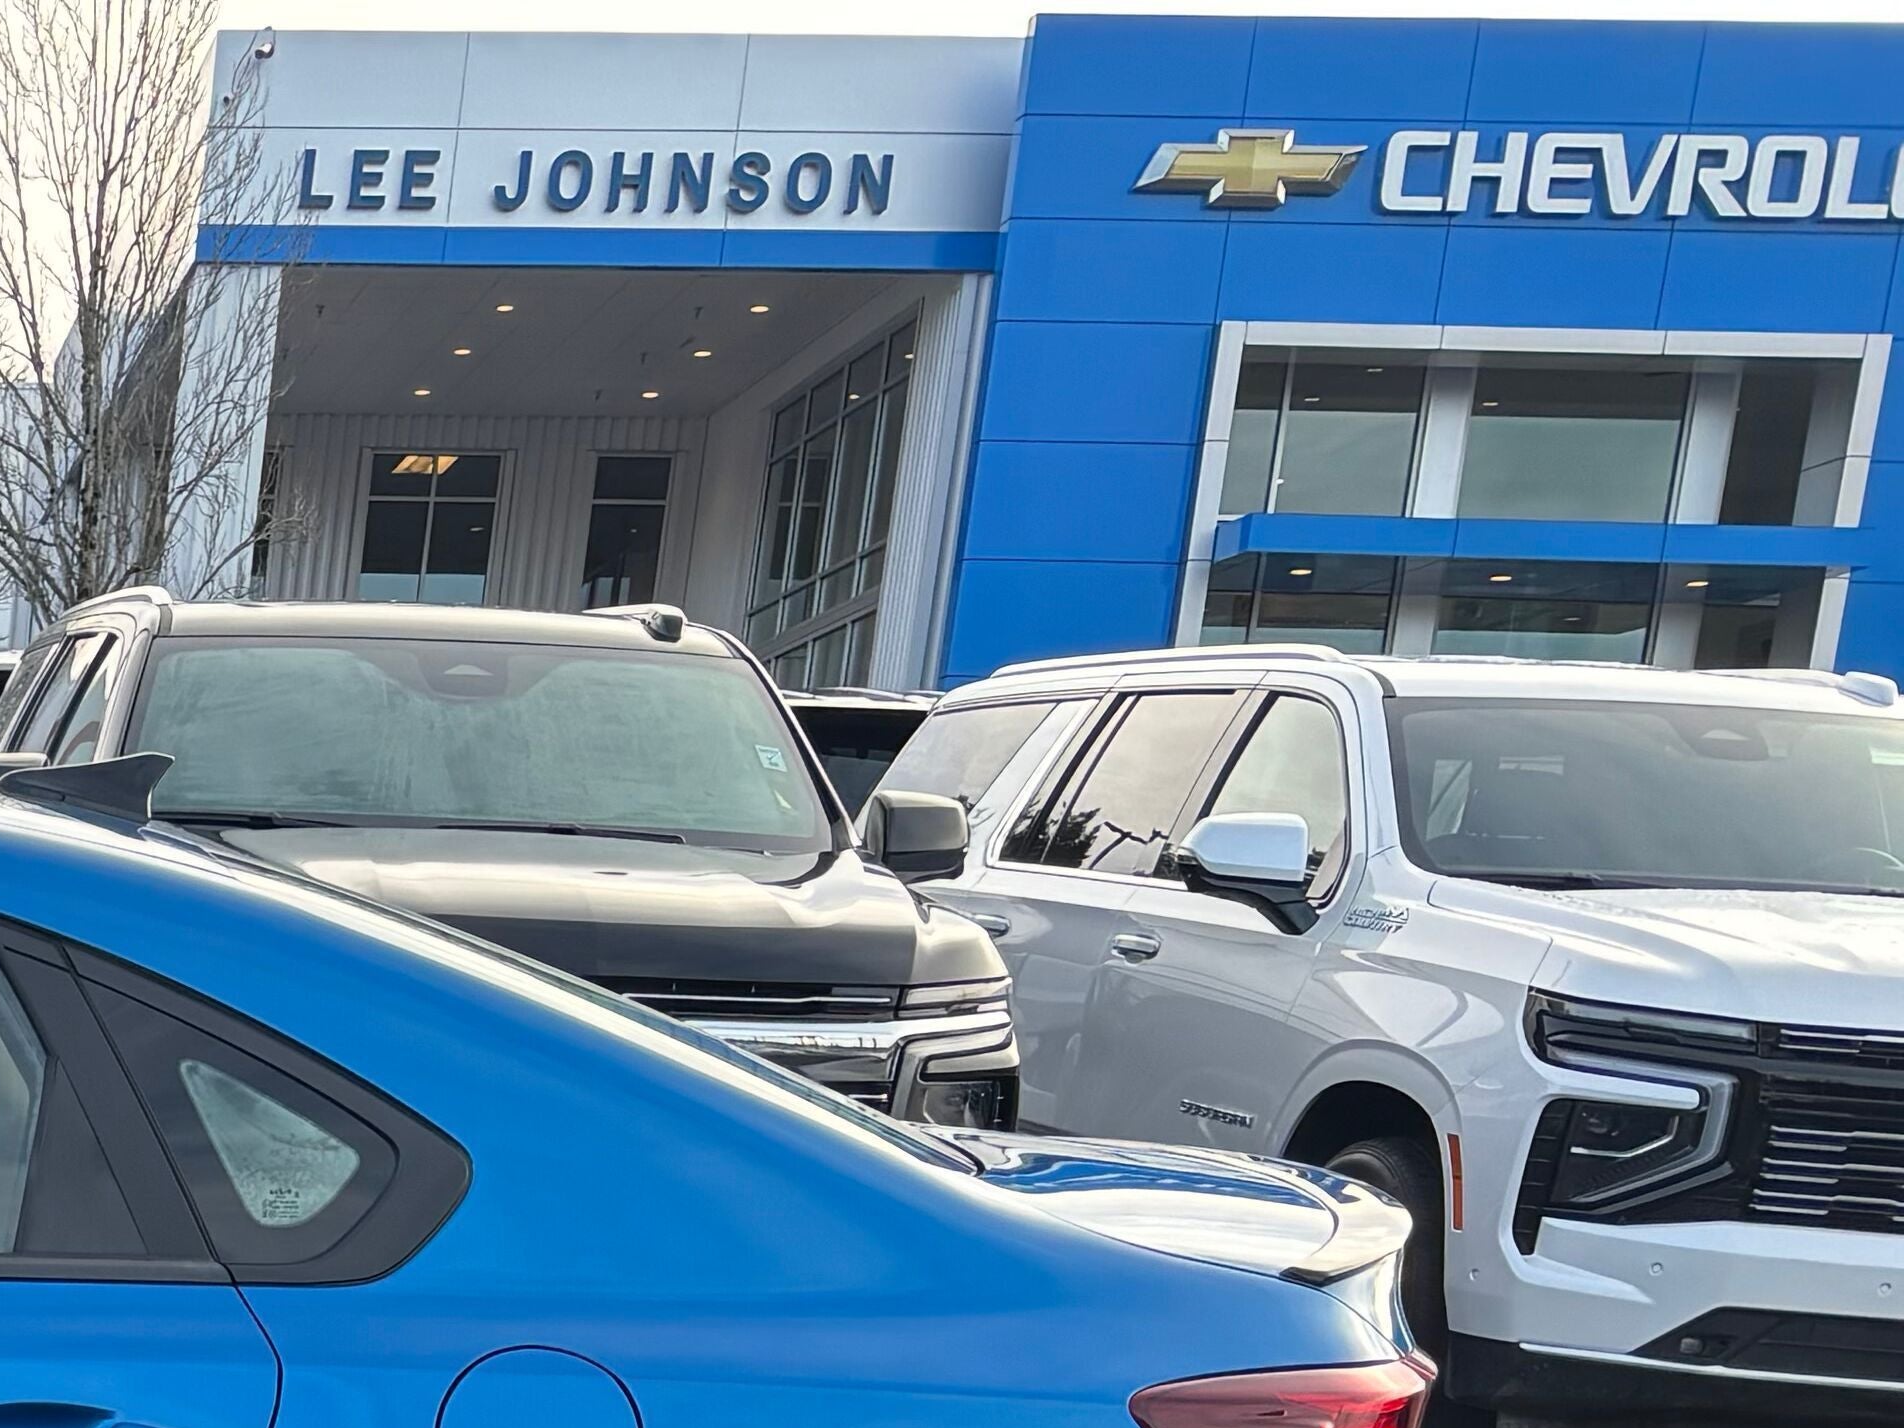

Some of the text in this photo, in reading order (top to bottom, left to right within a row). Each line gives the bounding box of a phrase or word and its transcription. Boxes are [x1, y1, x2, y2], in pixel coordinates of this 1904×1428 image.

[298, 149, 894, 216] LEE JOHNSON
[1382, 131, 1903, 219] CHEVROL
